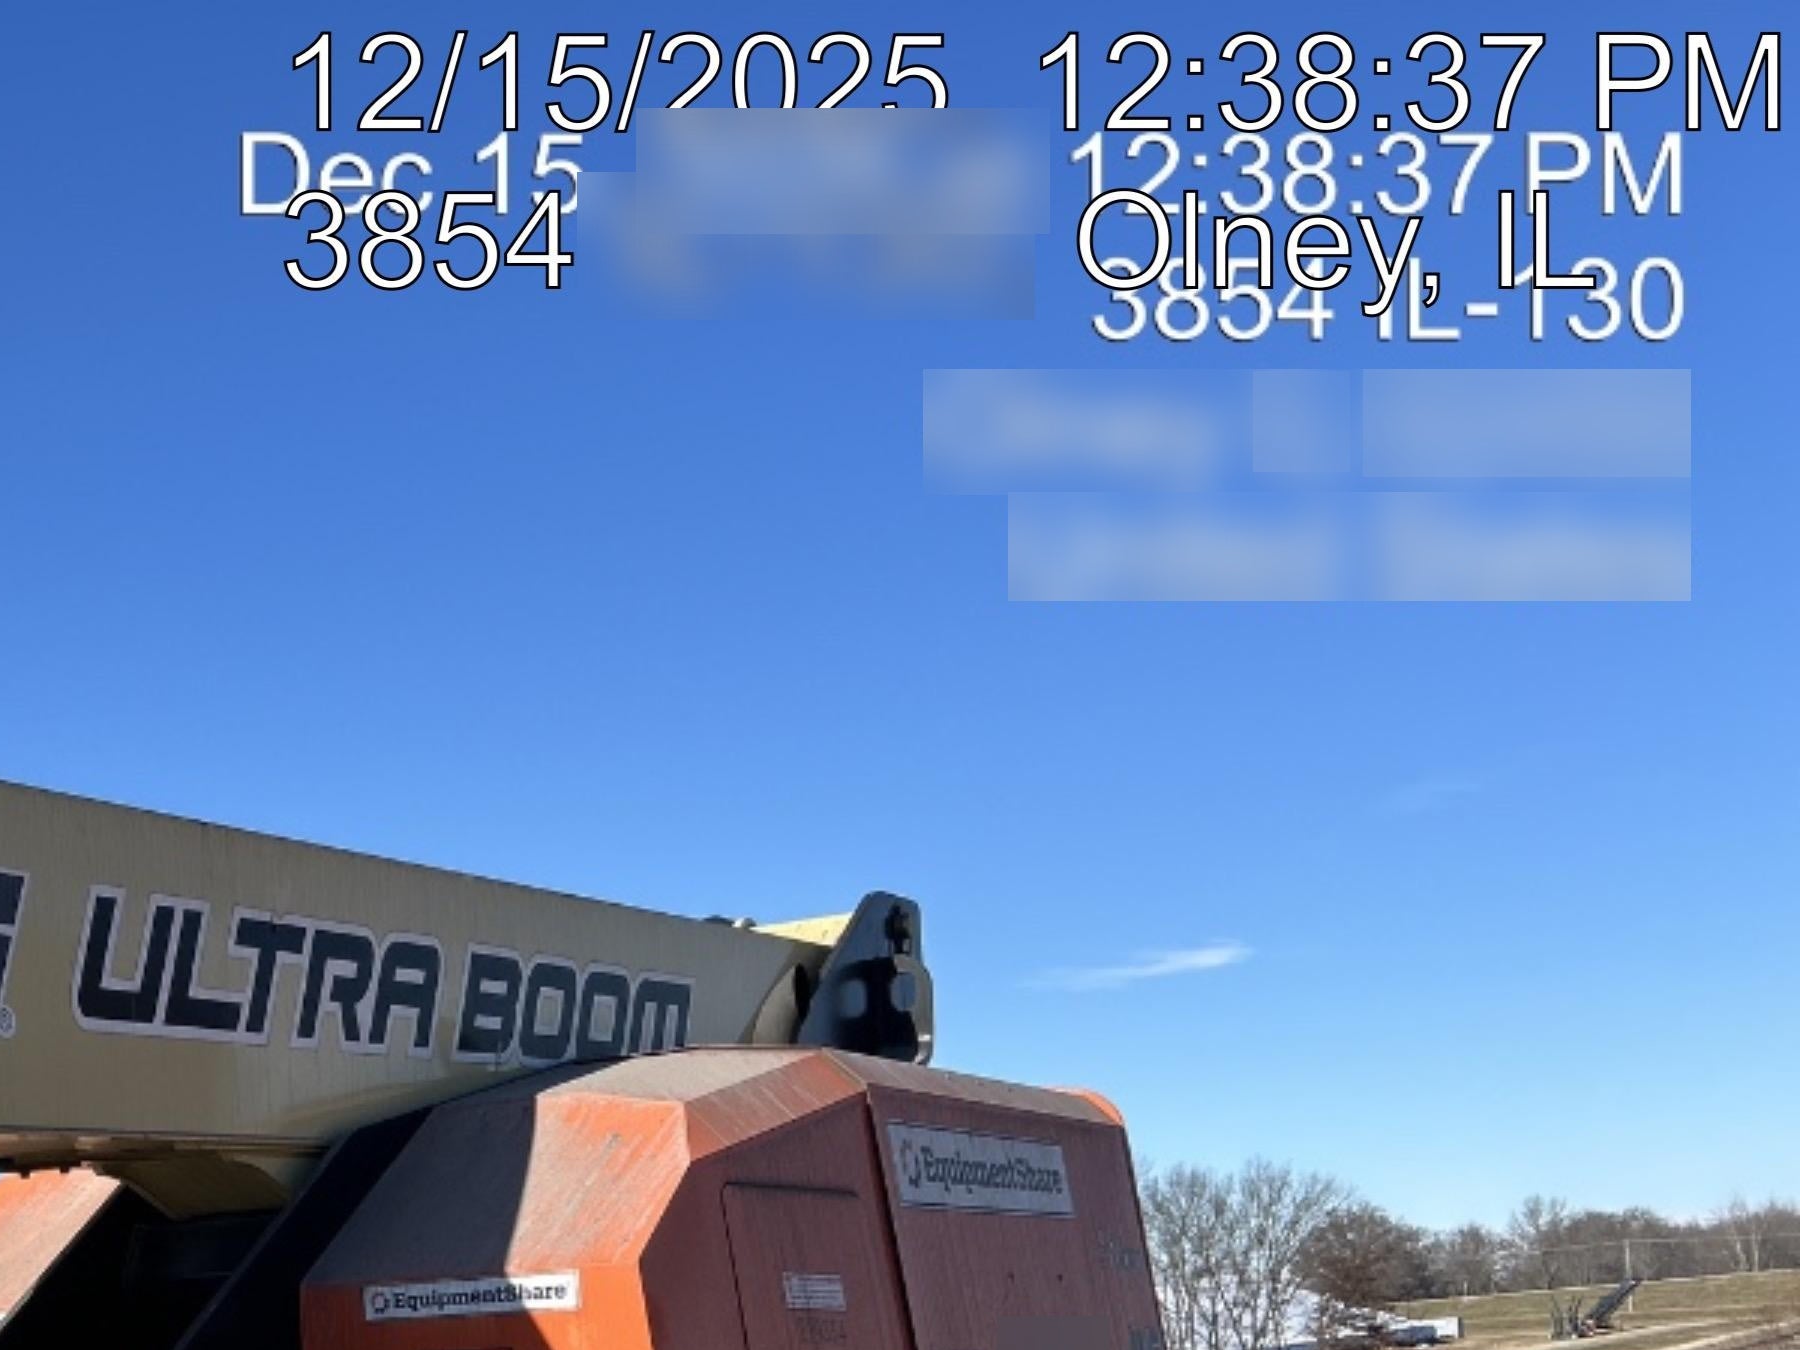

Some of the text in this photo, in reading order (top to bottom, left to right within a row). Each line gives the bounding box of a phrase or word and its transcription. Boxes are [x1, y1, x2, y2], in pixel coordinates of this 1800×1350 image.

[71, 884, 695, 1067] ULTRA BOOM
[391, 1283, 569, 1313] EquipmentShare
